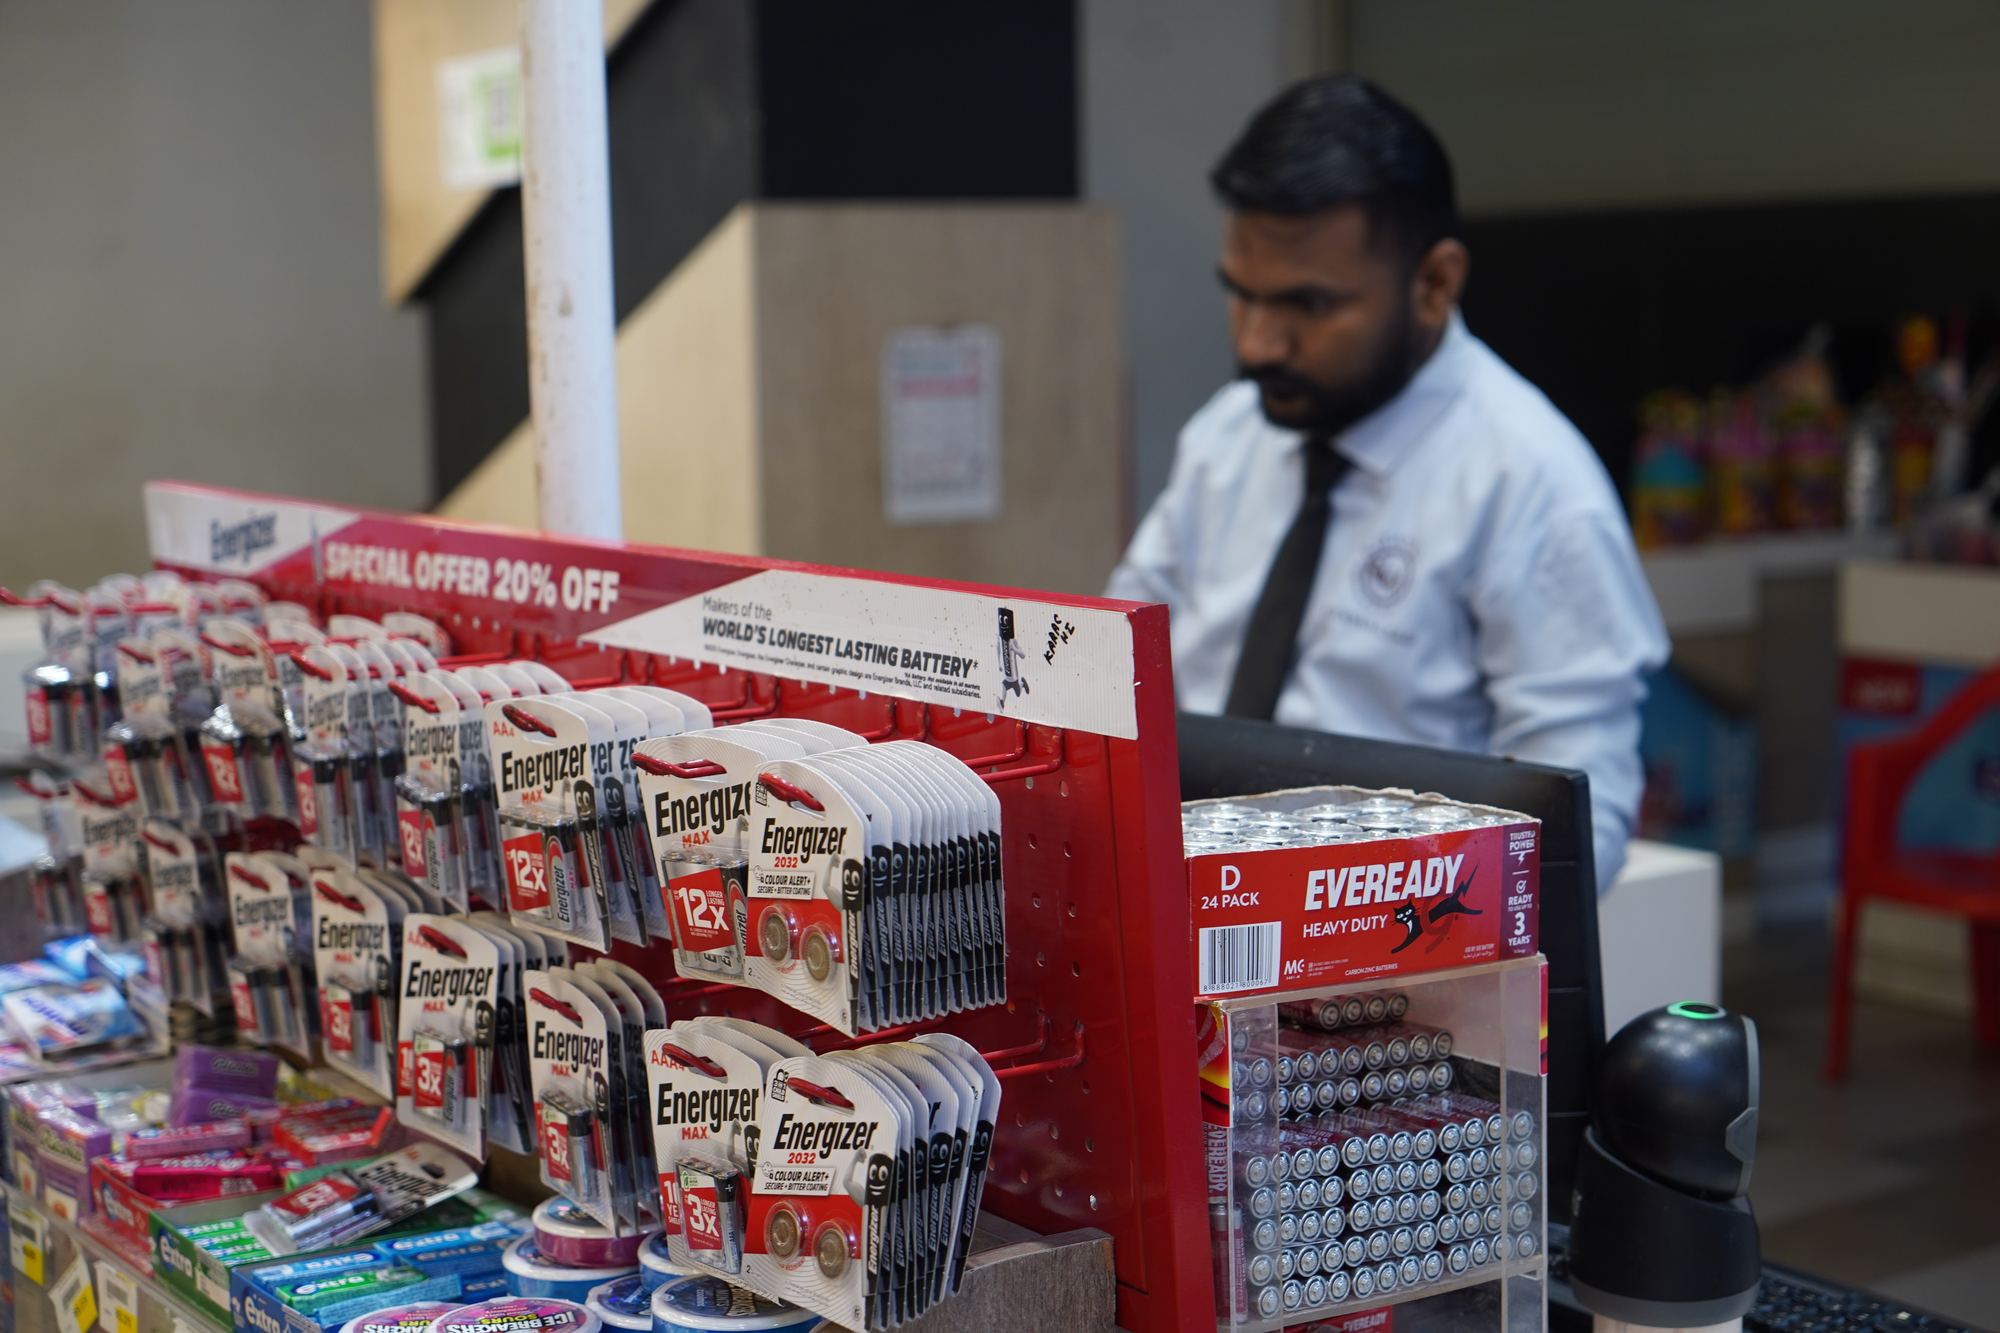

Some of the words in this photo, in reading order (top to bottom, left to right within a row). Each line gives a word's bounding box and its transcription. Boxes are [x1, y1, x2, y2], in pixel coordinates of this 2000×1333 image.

[210, 511, 277, 563] Energizer
[325, 541, 412, 589] SPECIAL
[414, 550, 490, 598] OFFER
[494, 558, 557, 607] 20%
[562, 566, 620, 613] OFF
[703, 596, 739, 616] Makers
[741, 602, 753, 618] of
[754, 604, 773, 621] the
[702, 616, 767, 645] WORLD'S
[769, 627, 834, 656] LONGEST
[835, 638, 898, 667] LASTING
[872, 672, 894, 685] Energizer
[913, 680, 922, 689] LLC
[934, 684, 951, 694] related
[951, 687, 981, 699] subsidiaries.
[408, 720, 457, 764] Energizer
[501, 743, 587, 794] Energizer
[521, 789, 544, 806] MAX
[681, 829, 711, 848] MAX
[761, 817, 848, 864] Energizer
[1509, 830, 1536, 841] TRUSTED
[1509, 839, 1535, 851] POWER
[774, 856, 799, 869] 2032
[757, 886, 774, 894] SECURE
[793, 887, 811, 896] COATING
[765, 874, 789, 885] COLOUR
[1221, 865, 1241, 892] D
[1304, 853, 1465, 911] EVEREADY
[552, 865, 571, 924] Energizer
[1201, 895, 1219, 910] 24
[1221, 891, 1260, 908] PACK
[1508, 893, 1534, 906] READY
[319, 914, 385, 958] Energizer
[1303, 919, 1349, 939] HEAVY
[1351, 914, 1388, 932] DUTY
[1514, 911, 1526, 936] 3
[848, 911, 859, 980] Energizer
[405, 961, 494, 1006] Energizer
[423, 1000, 446, 1013] MAX
[533, 1020, 604, 1074] Energizer
[551, 1062, 570, 1078] MAX
[657, 1082, 760, 1134] Energizer
[681, 1125, 708, 1140] MAX
[774, 1113, 879, 1159] Energizer
[787, 1152, 817, 1164] 2032
[764, 1182, 785, 1190] SECURE
[788, 1182, 806, 1191] BITTER
[806, 1183, 828, 1192] COATING
[774, 1171, 803, 1181] COLOUR
[803, 1171, 830, 1182] ALERT+
[392, 1233, 461, 1251] extra
[868, 1205, 879, 1275] Energizer
[160, 1234, 193, 1278] extra
[305, 1253, 375, 1269] extra
[746, 1264, 752, 1274] 2
[295, 1276, 365, 1295] extra
[245, 1296, 281, 1333] extra
[479, 1314, 539, 1325] SOURS
[544, 1312, 577, 1327] ICE
